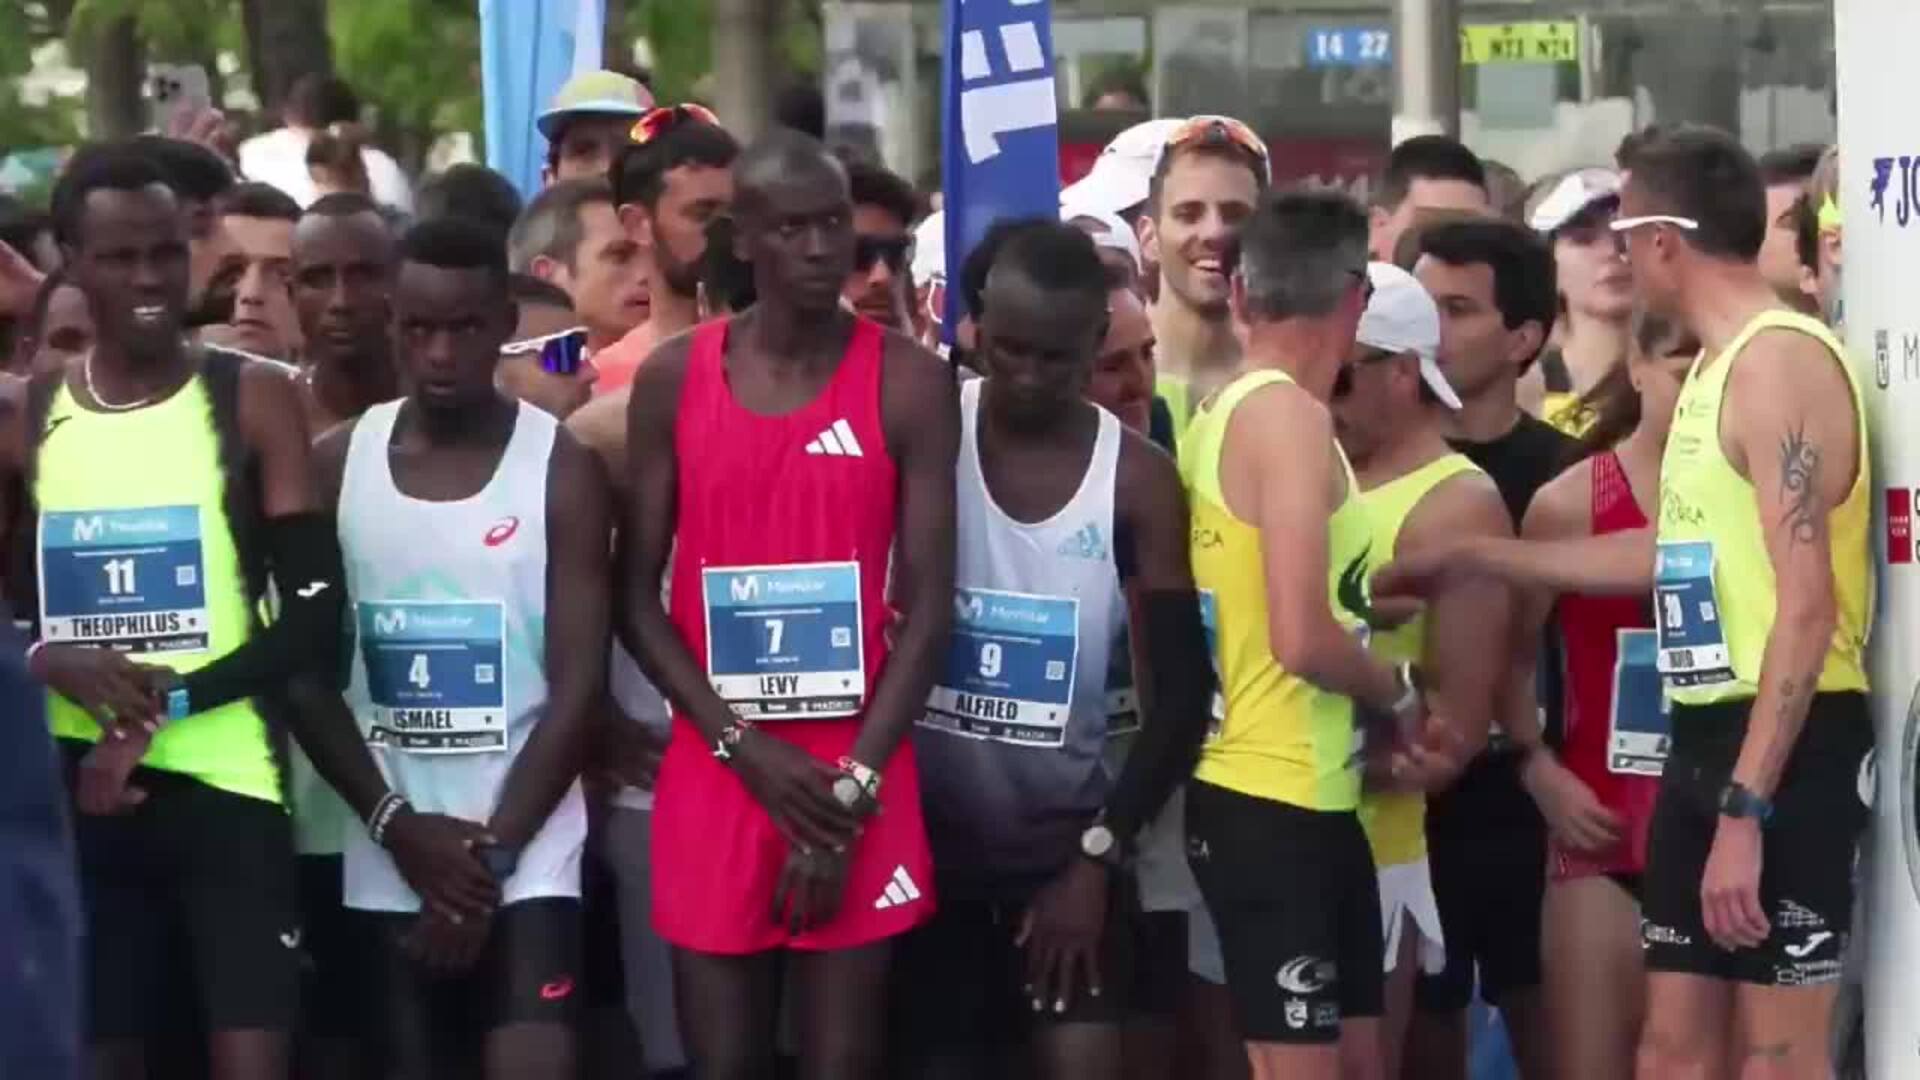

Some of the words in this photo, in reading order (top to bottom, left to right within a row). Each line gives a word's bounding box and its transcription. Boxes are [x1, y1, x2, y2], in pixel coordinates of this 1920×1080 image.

[1316, 32, 1343, 60] 14
[1359, 31, 1389, 60] 27
[103, 558, 136, 594] 11
[71, 612, 181, 638] THEOPHILUS
[765, 619, 784, 655] 7
[408, 654, 431, 689] 4
[979, 642, 1002, 678] 9
[760, 675, 799, 696] LEVY
[393, 709, 453, 729] ISMAEL
[955, 693, 1019, 721] ALFRED
